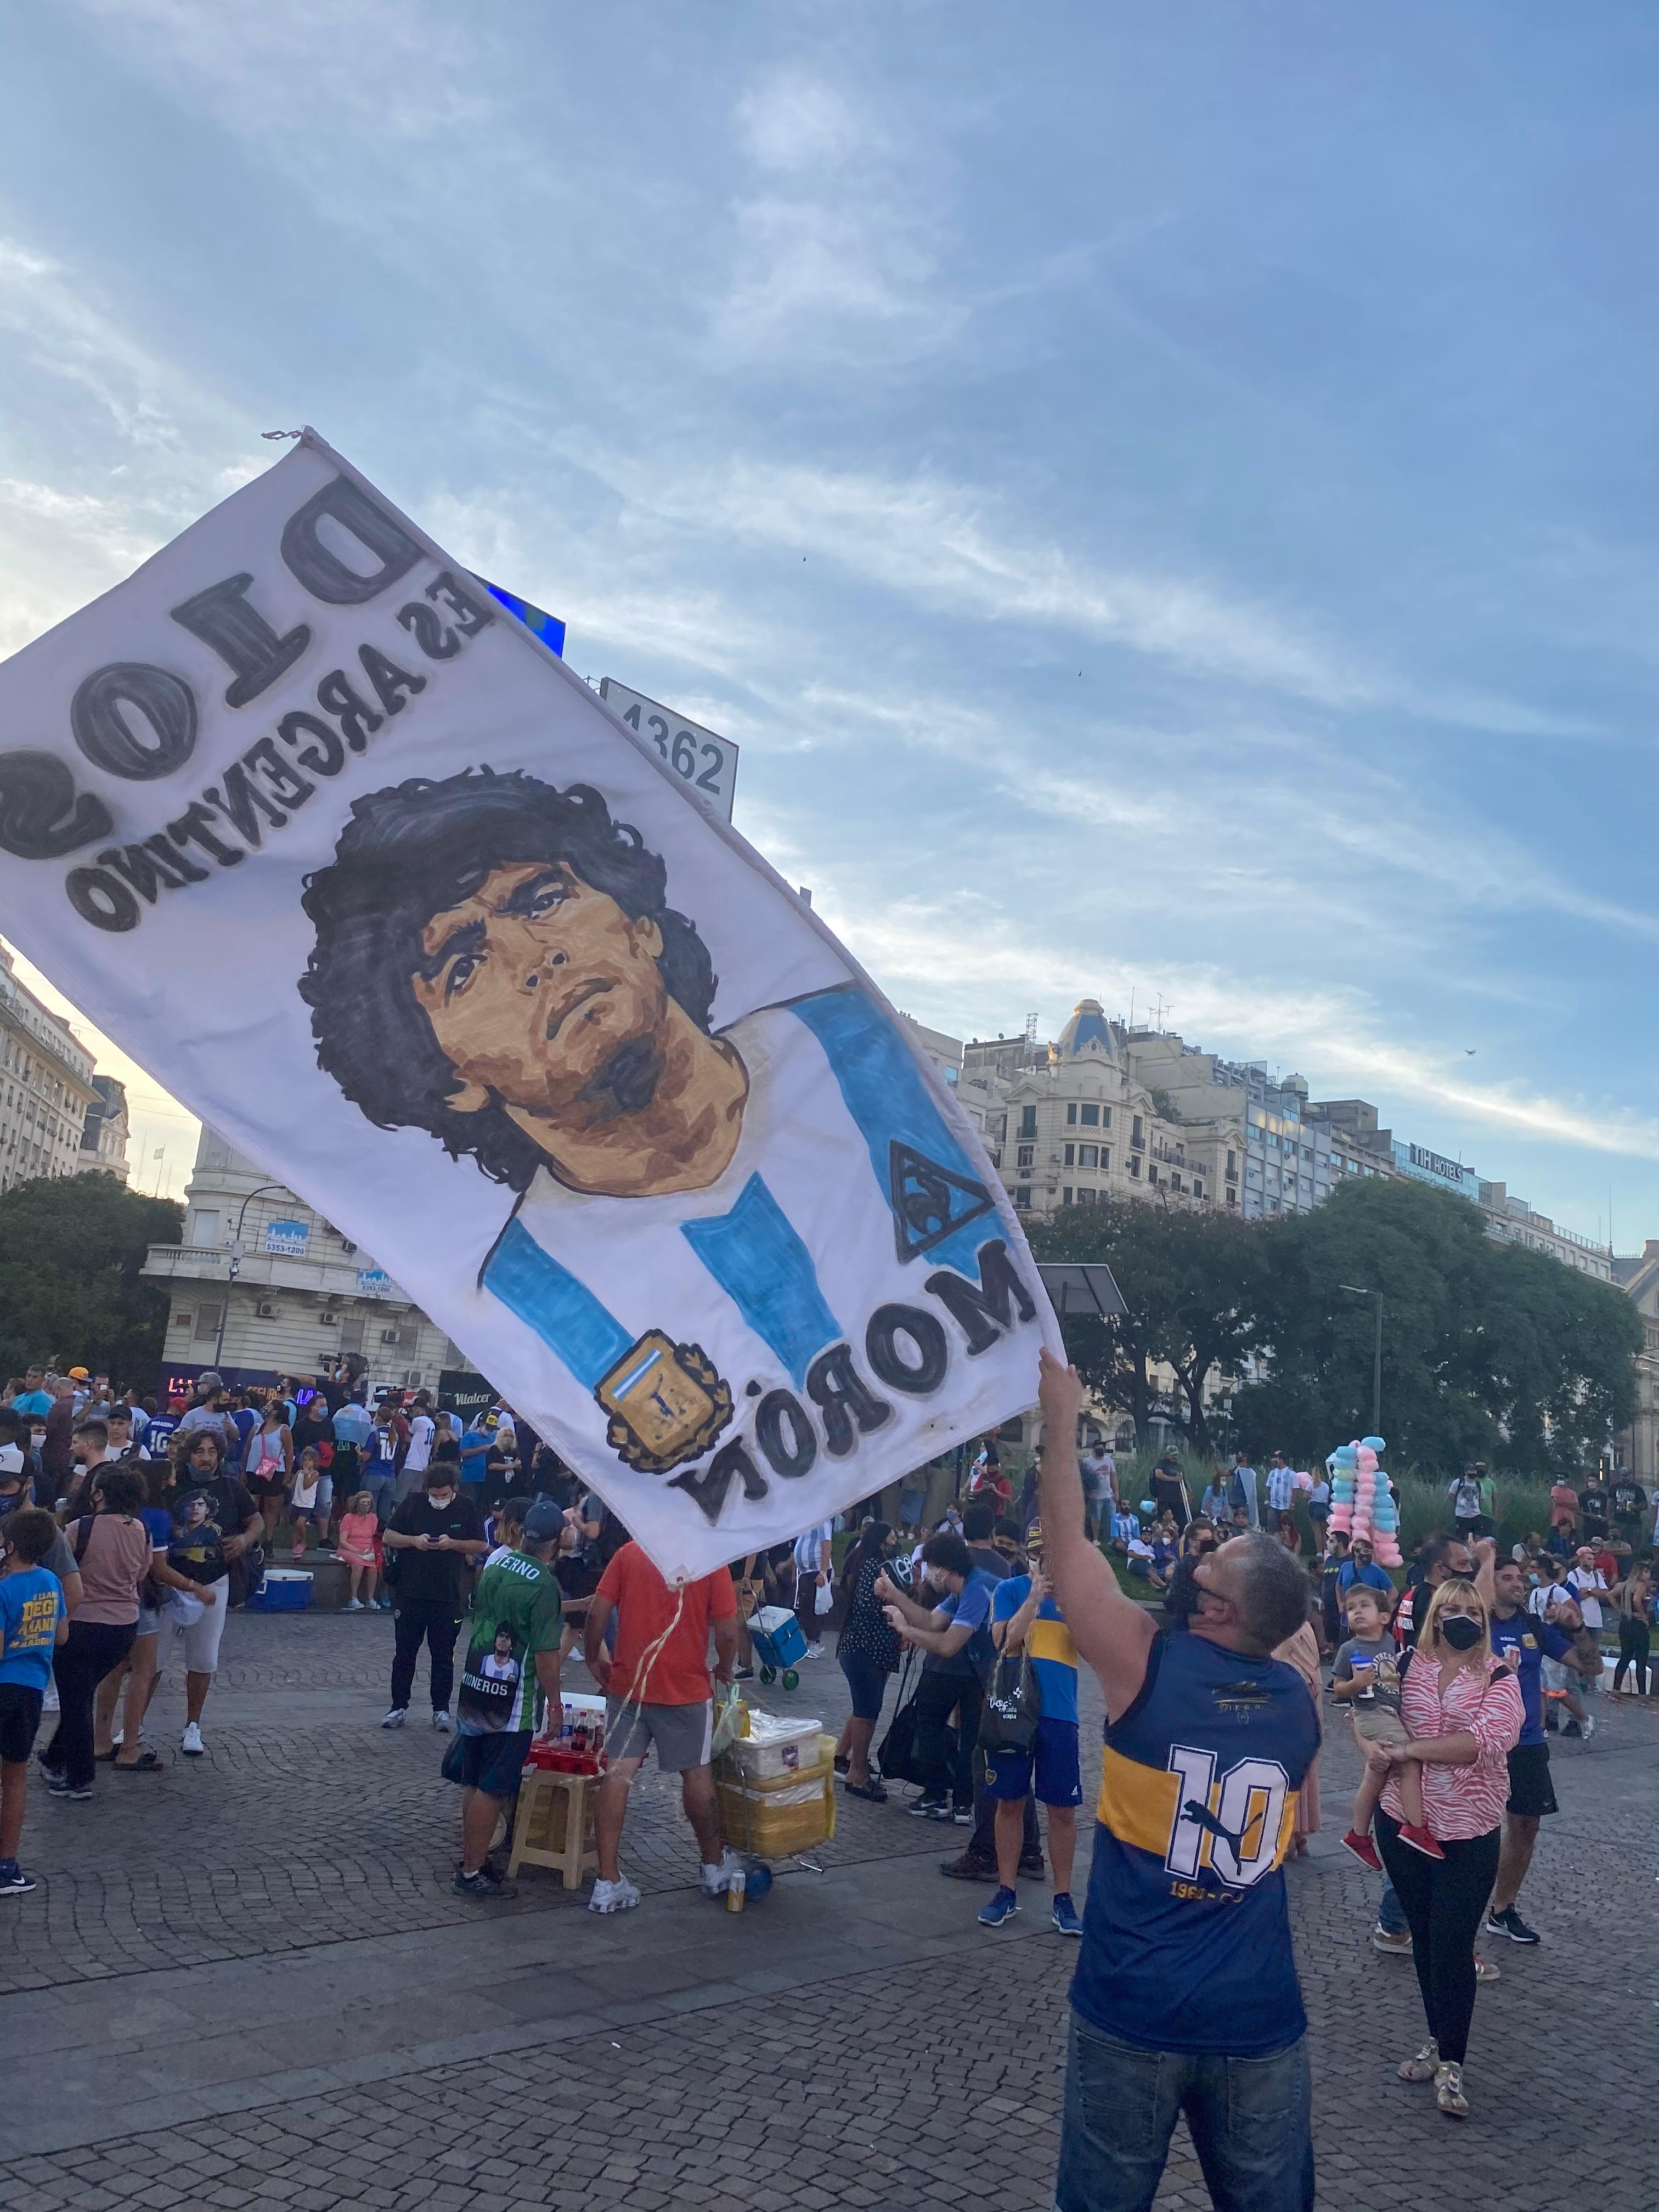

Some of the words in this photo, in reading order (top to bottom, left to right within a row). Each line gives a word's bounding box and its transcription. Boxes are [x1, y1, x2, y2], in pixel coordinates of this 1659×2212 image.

[1435, 1158, 1462, 1182] HOTELS
[267, 1243, 304, 1255] 5353-1200
[490, 1555, 540, 1580] TERNO
[1164, 1743, 1290, 1888] 10
